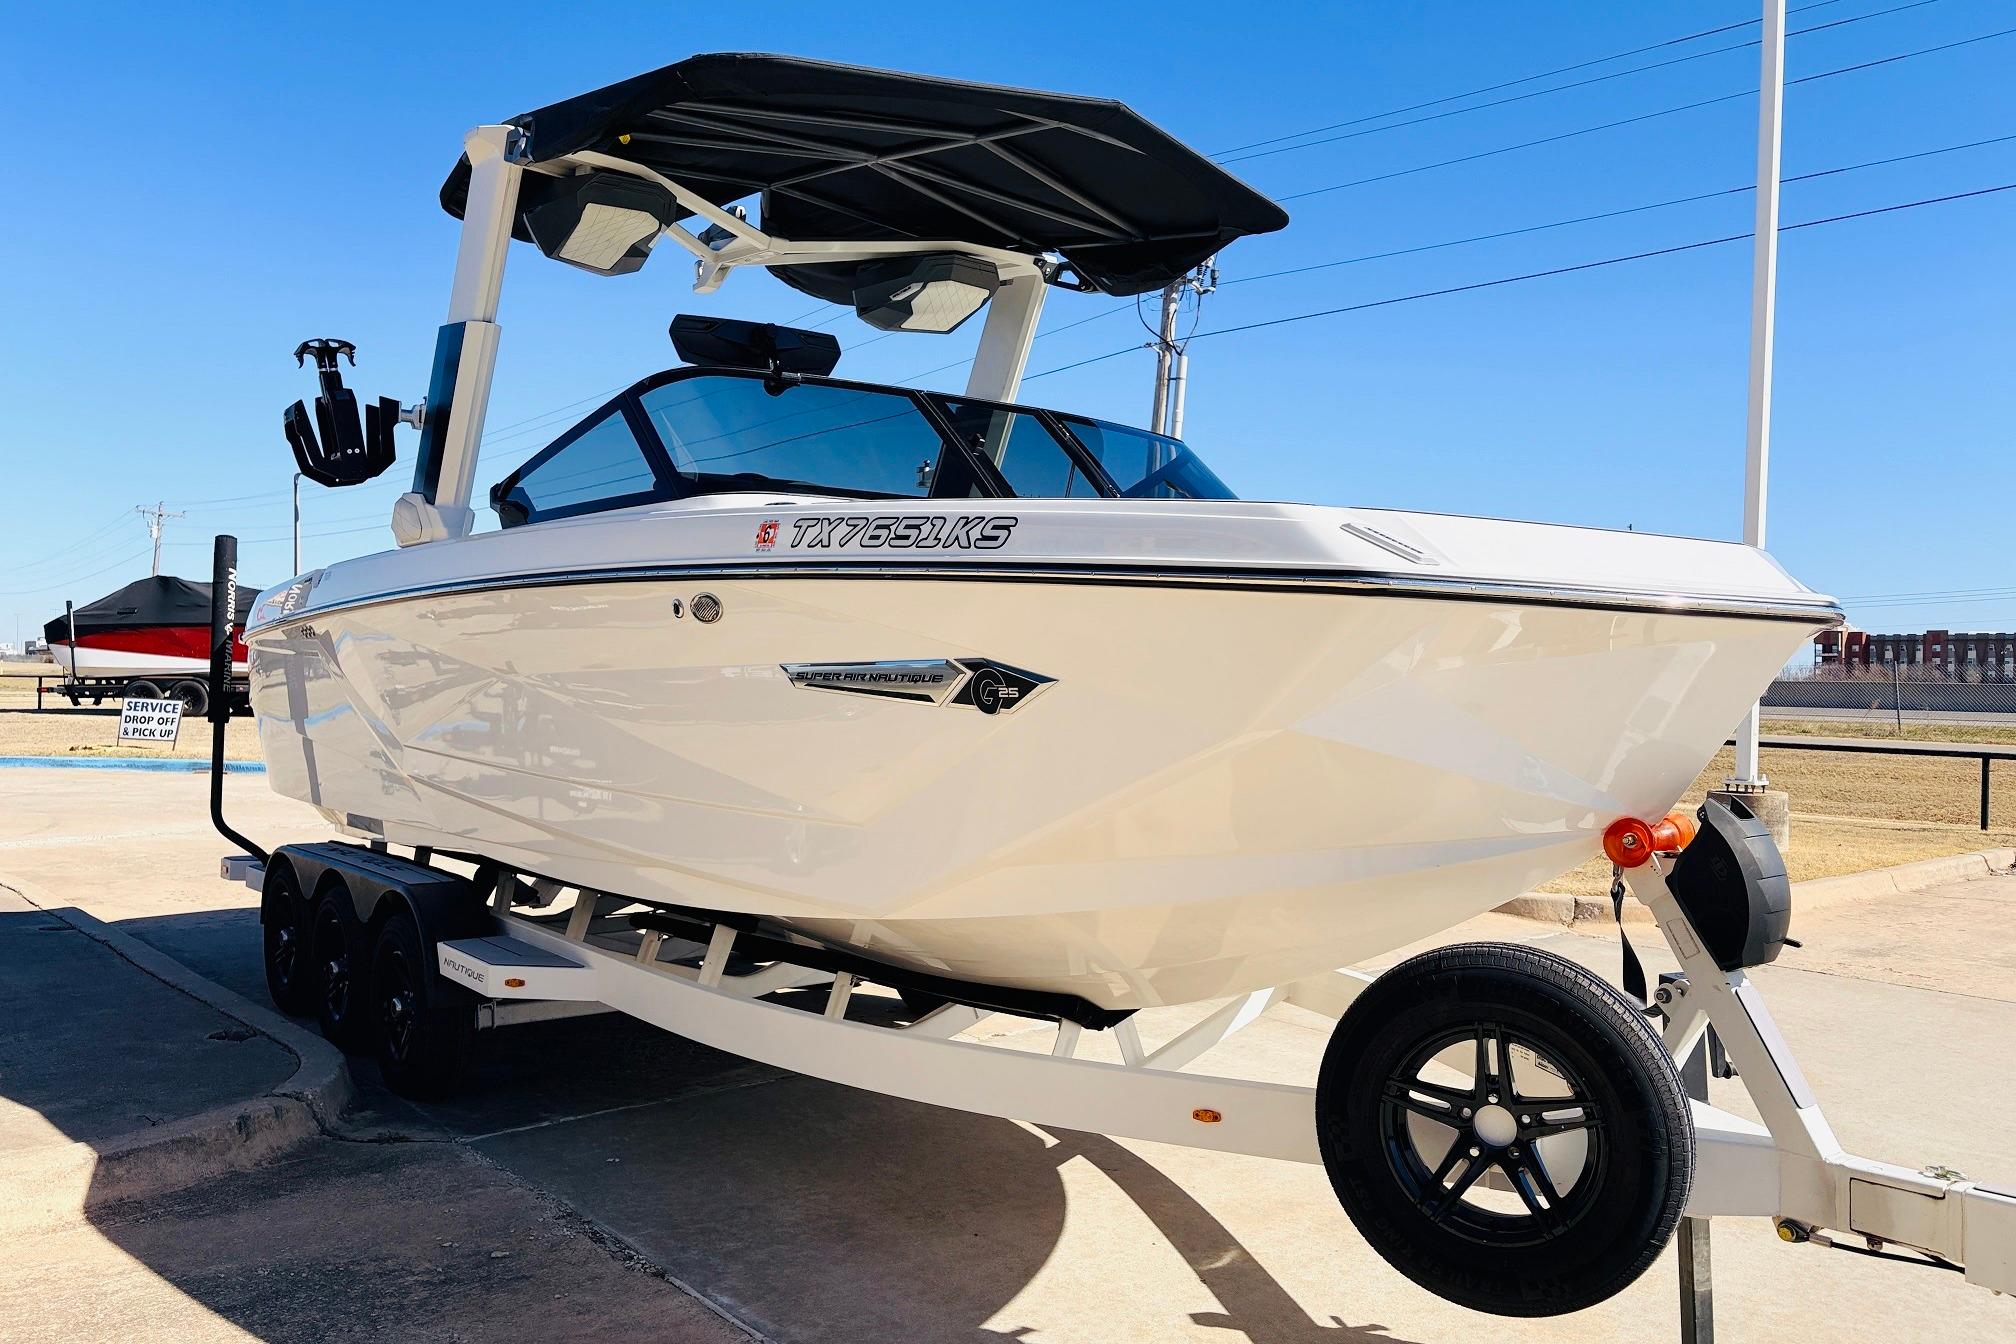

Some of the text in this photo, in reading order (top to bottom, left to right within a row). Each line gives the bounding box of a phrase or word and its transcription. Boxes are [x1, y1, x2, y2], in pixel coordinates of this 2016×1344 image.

[791, 516, 1018, 549] TX7651KS
[223, 567, 237, 693] NORRIS MARINE
[794, 672, 944, 684] SUPER AIR NAUTIQUE
[126, 701, 179, 713] SERVICE
[124, 715, 176, 726] DROP OFF
[122, 726, 173, 738] & PICK UP
[443, 957, 485, 983] NAUTIQUE
